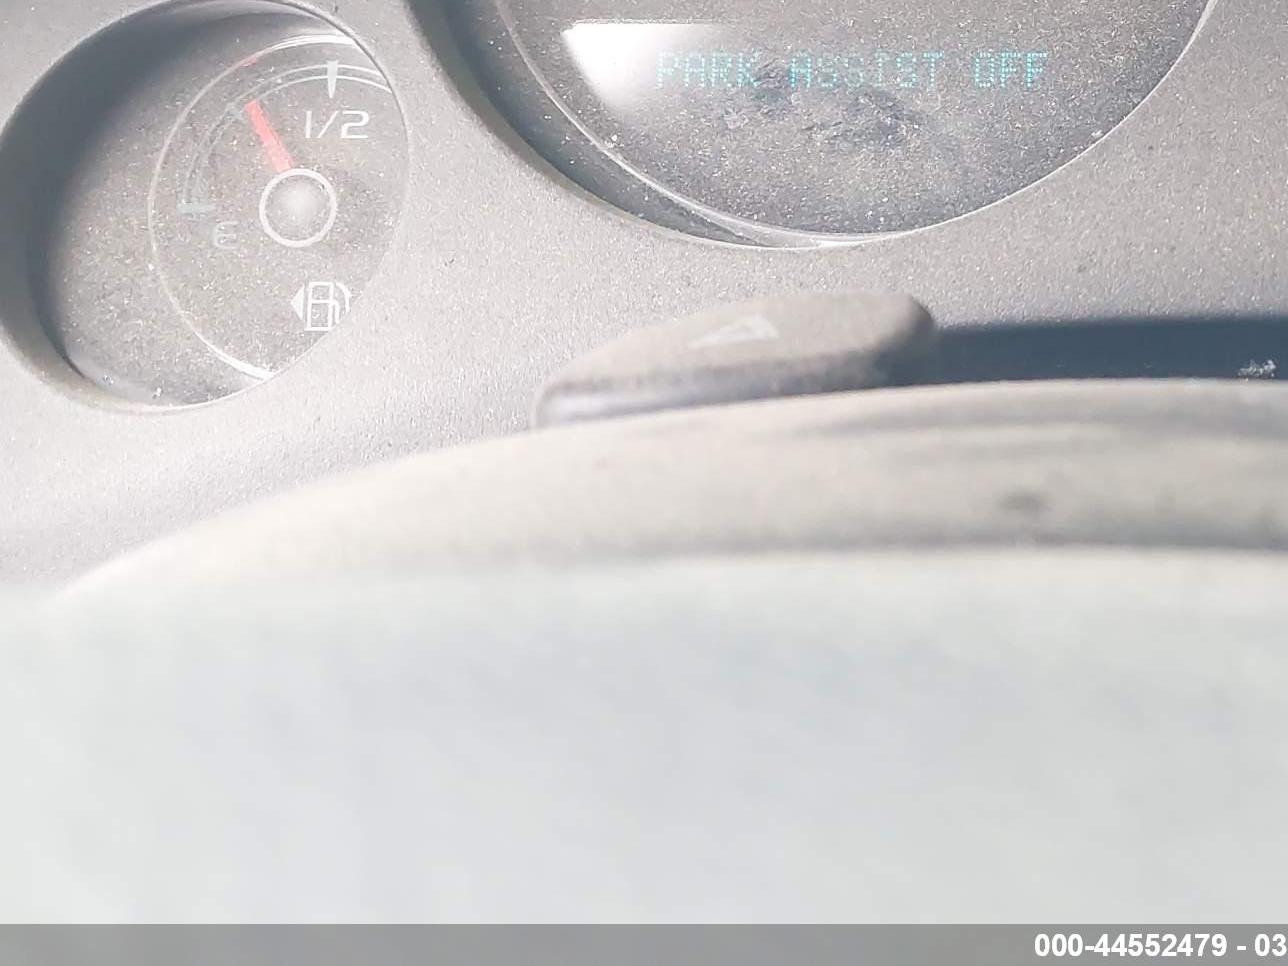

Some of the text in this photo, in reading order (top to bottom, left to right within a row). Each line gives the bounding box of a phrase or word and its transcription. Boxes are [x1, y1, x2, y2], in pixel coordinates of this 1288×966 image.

[655, 51, 1048, 89] PARK ASSIST OFF
[305, 109, 370, 139] 1/2
[212, 221, 239, 250] E
